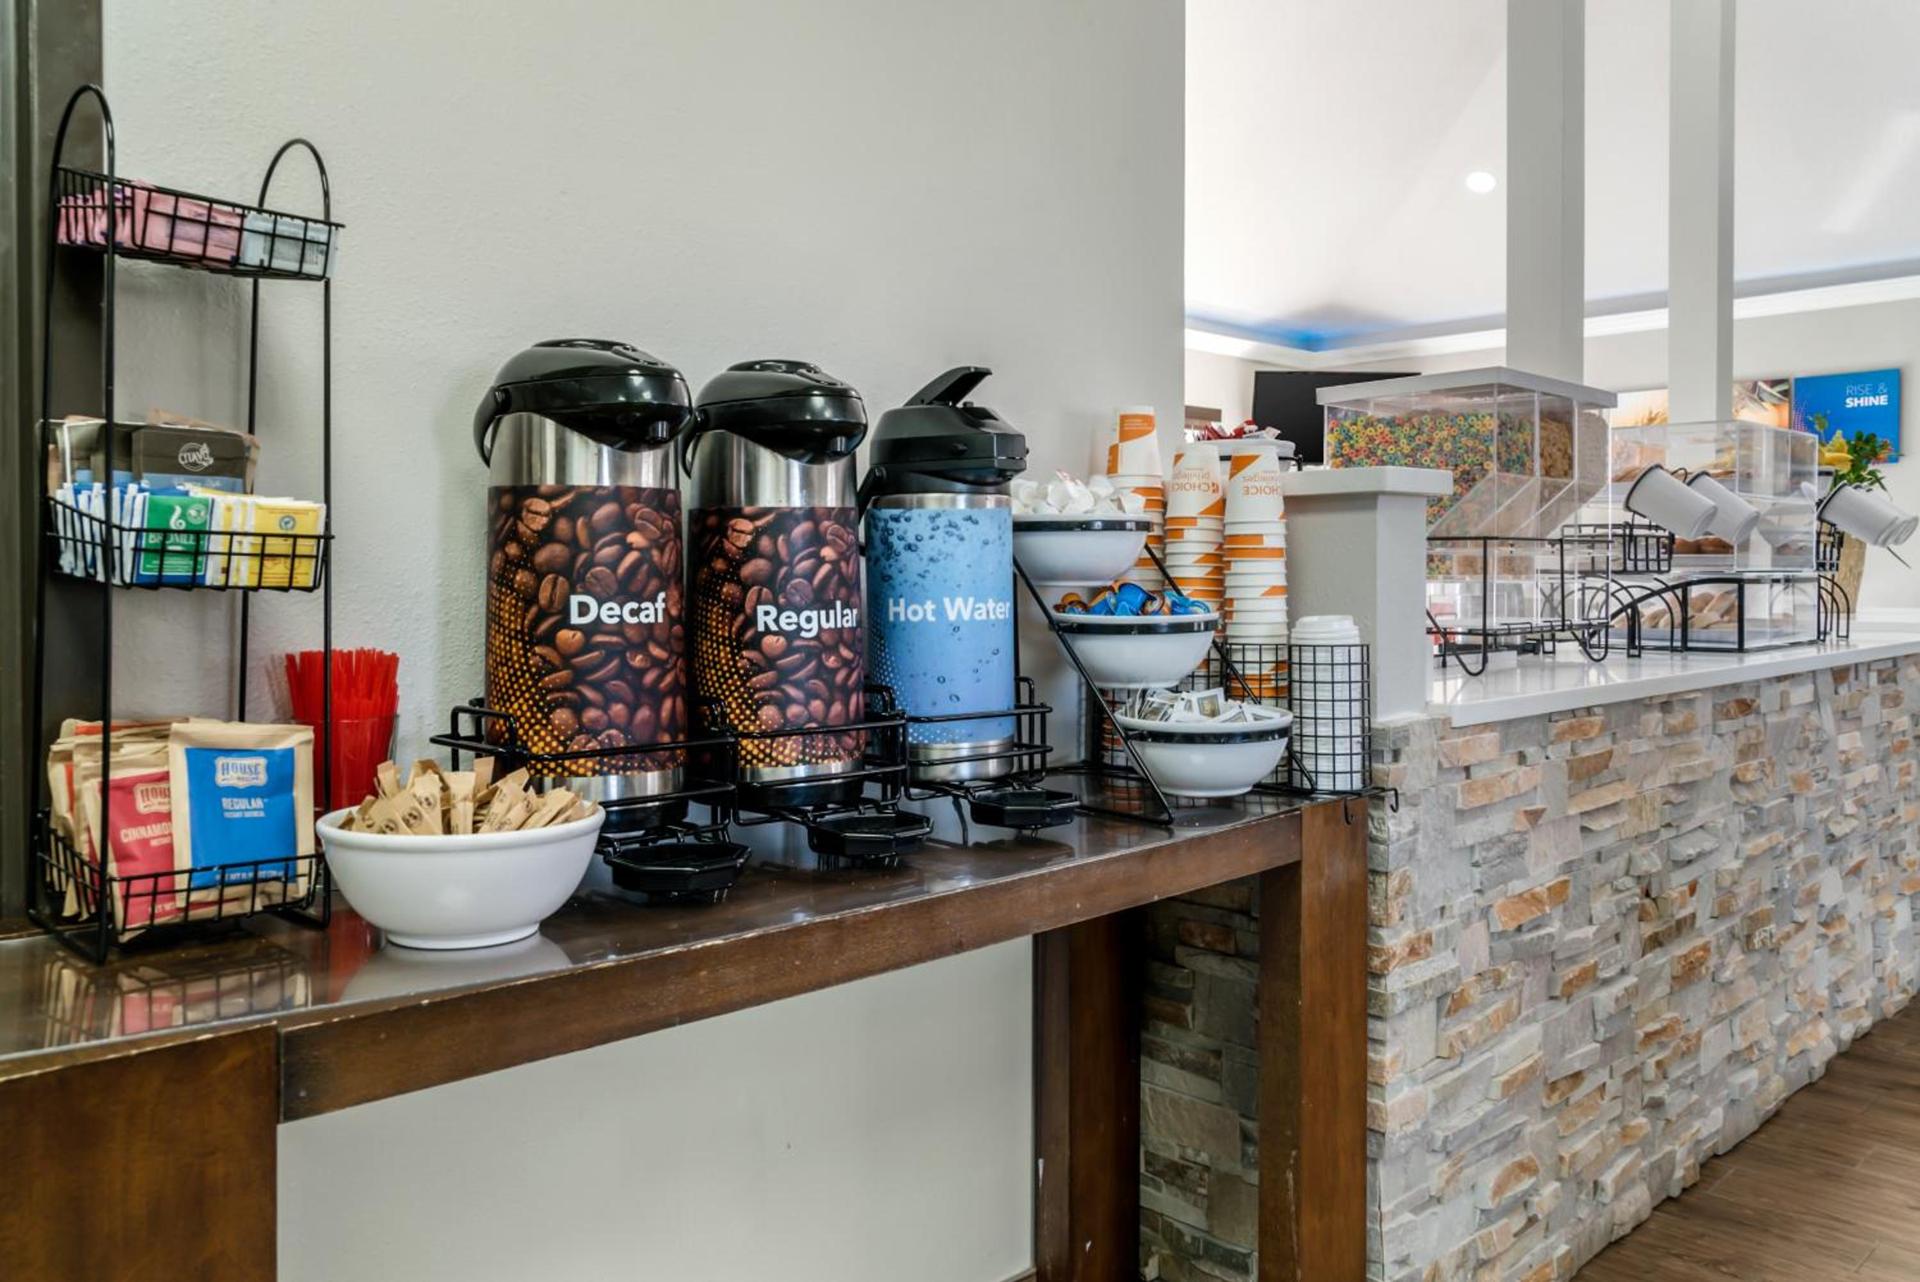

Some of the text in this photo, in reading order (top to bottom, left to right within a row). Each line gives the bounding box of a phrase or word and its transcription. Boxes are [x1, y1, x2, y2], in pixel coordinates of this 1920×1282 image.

[1846, 382, 1888, 396] RISE &
[1845, 394, 1888, 408] SHINE
[1242, 486, 1281, 496] HOICE
[569, 590, 666, 626] Decaf
[887, 596, 1011, 622] Hot Water
[756, 604, 858, 638] Regular
[221, 762, 261, 776] HOUSE
[221, 796, 265, 811] REGULAR
